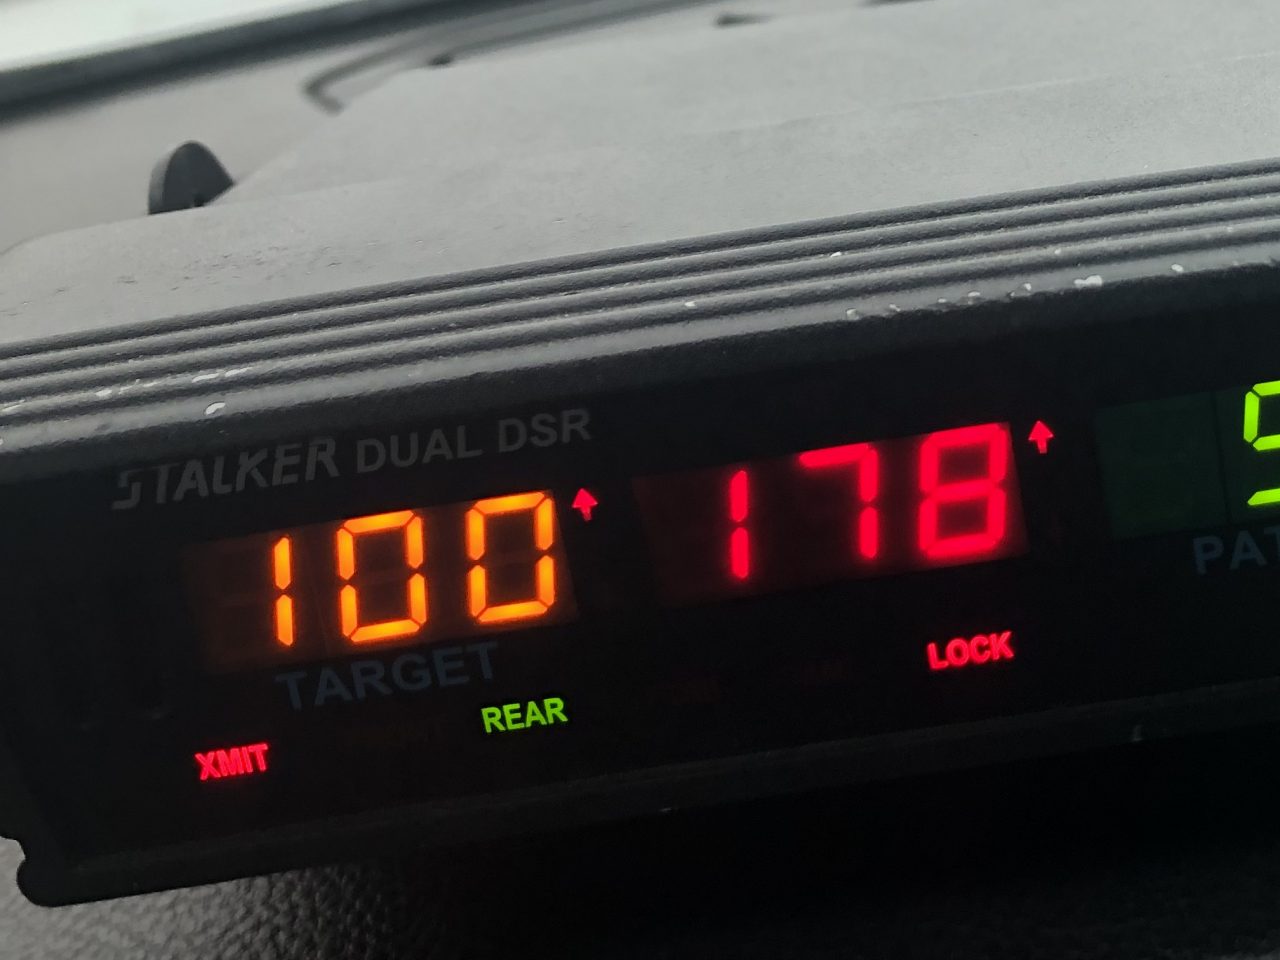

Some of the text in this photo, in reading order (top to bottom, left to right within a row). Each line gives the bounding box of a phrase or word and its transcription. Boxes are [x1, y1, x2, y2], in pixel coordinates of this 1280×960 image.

[112, 409, 593, 510] STALKER DUAL DSR
[730, 423, 1008, 579] 178
[273, 490, 555, 646] 100
[277, 643, 498, 711] TARGET
[927, 631, 1015, 670] LOCK
[482, 697, 568, 733] REAR
[195, 743, 269, 781] XMIT
